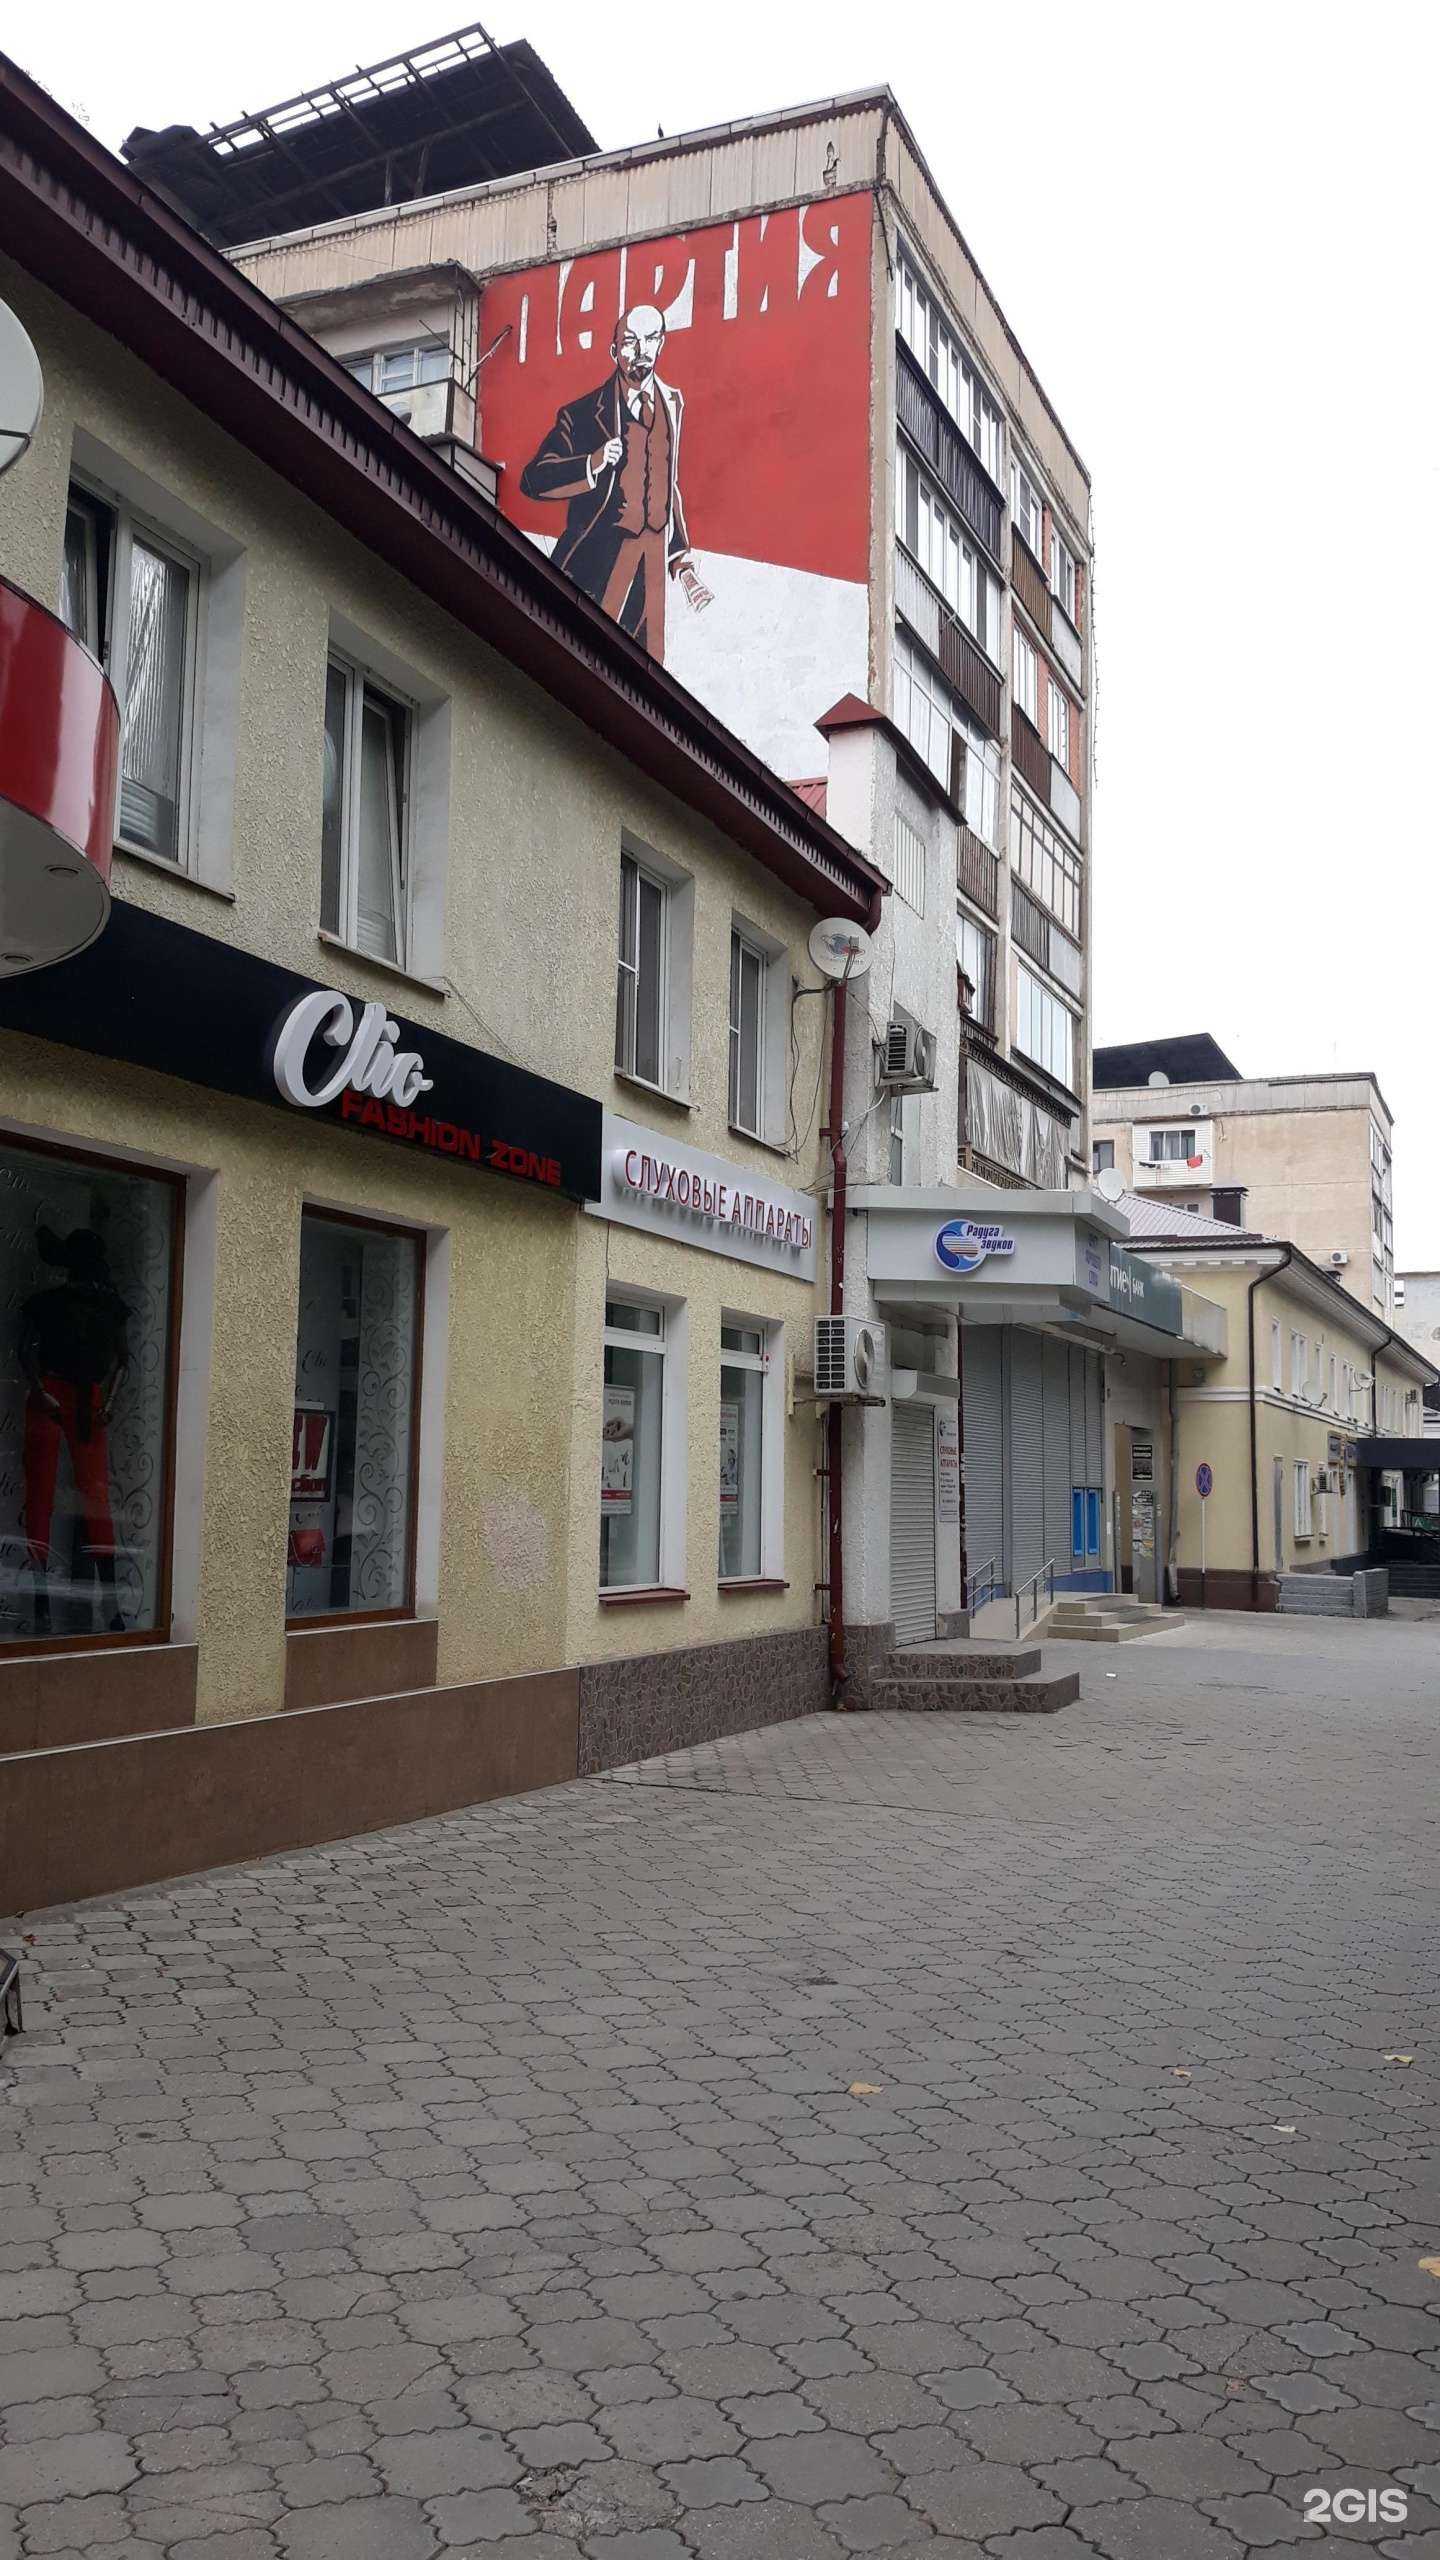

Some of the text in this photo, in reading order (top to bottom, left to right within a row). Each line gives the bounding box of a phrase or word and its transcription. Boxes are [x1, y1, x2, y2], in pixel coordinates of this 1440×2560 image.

[341, 1089, 562, 1186] FASHION ZONE
[624, 1149, 813, 1249] СЛУХОВЫЕ АППАРАТЫ
[966, 1225, 1000, 1239] Радуга
